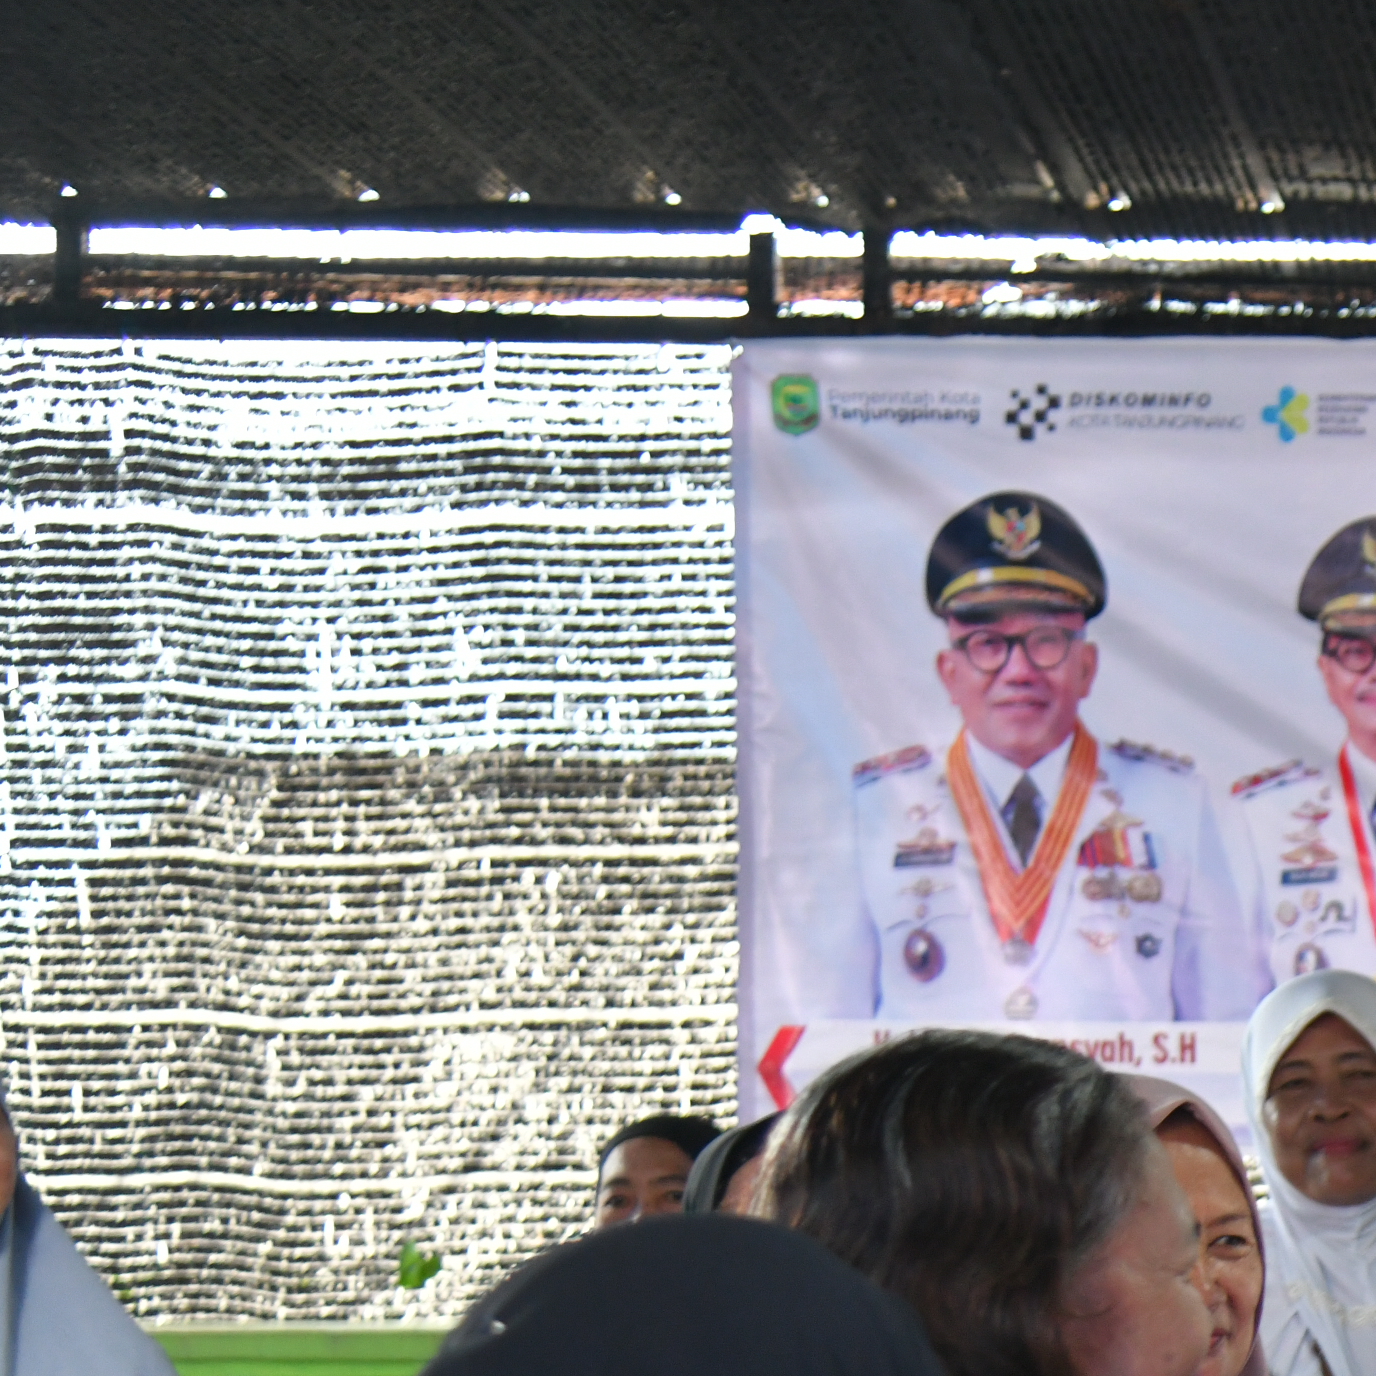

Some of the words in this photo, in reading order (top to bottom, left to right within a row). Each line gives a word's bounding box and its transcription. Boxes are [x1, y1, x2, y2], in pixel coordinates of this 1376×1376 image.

[939, 388, 982, 405] Kota
[1068, 391, 1213, 409] DISKOMINFO
[829, 403, 981, 425] Tanjungpinang
[1153, 1031, 1197, 1064] S.H
